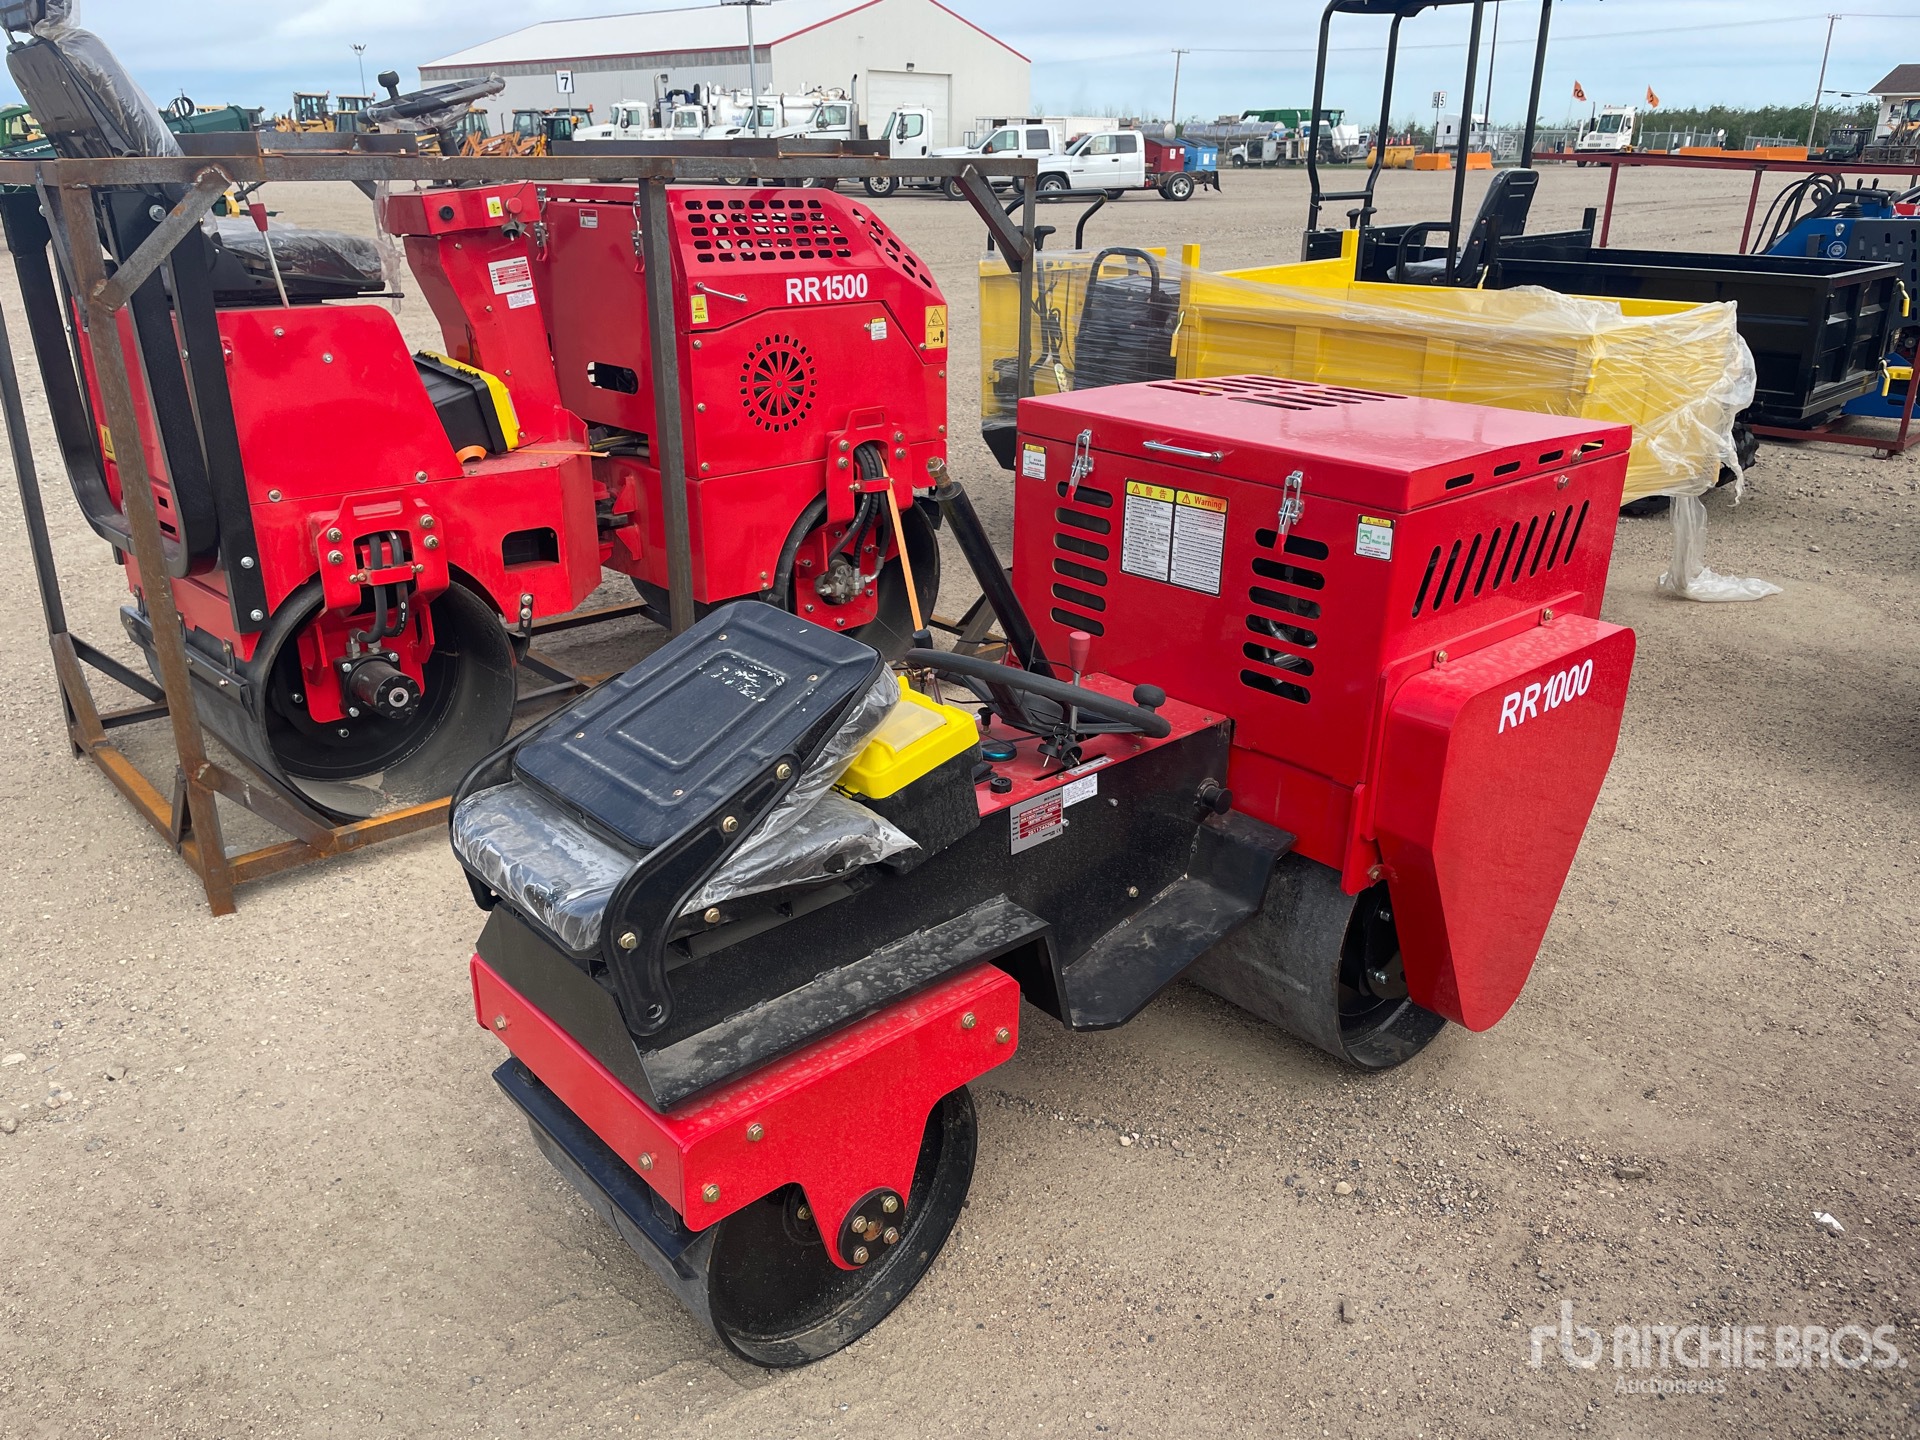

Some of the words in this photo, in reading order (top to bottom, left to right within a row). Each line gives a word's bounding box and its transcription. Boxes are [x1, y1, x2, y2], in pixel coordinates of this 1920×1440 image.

[560, 77, 568, 91] 7
[786, 273, 868, 304] RR1500
[1194, 496, 1223, 510] Warning
[1498, 659, 1593, 734] RR1000
